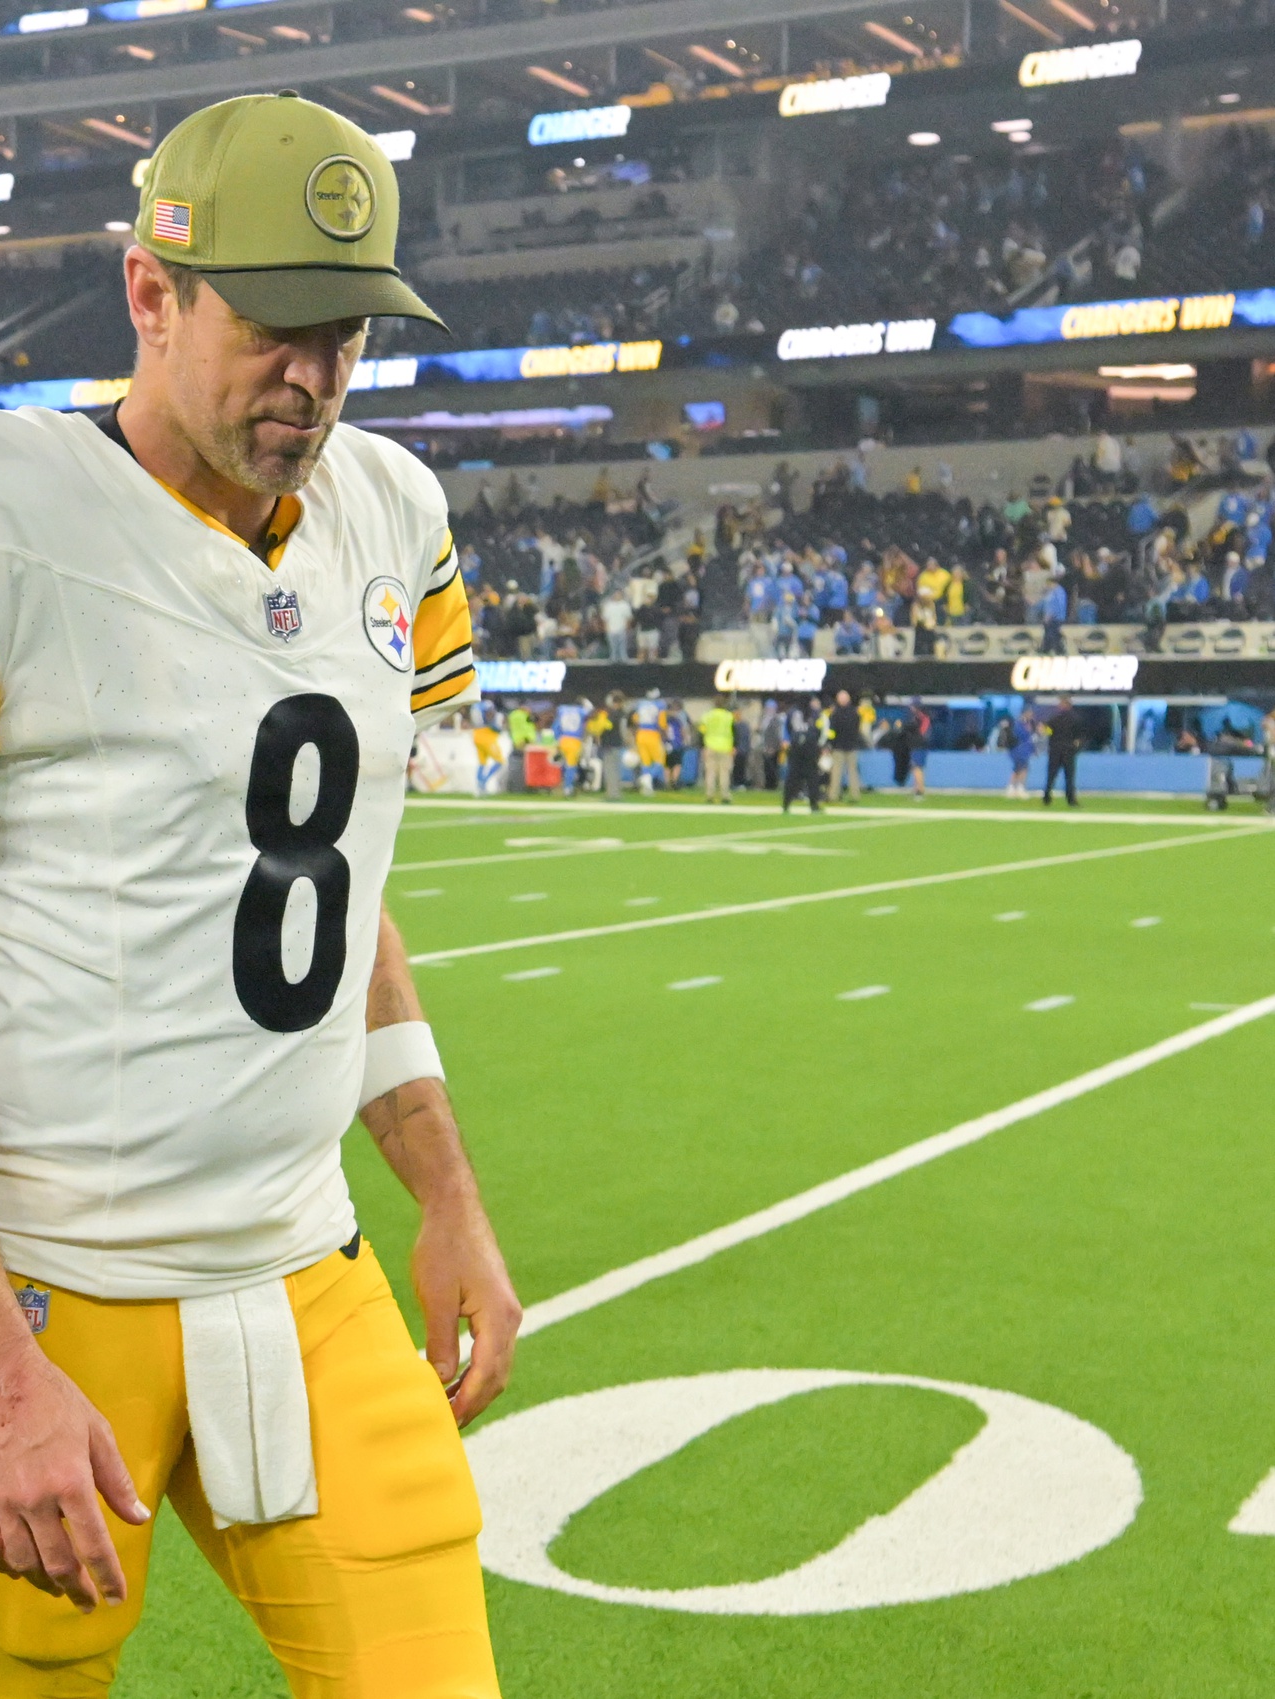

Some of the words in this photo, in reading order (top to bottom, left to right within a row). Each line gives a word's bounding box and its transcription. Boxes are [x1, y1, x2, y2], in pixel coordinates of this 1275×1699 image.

[273, 610, 298, 632] NFL
[370, 617, 393, 628] Steelers
[232, 692, 361, 1034] 8
